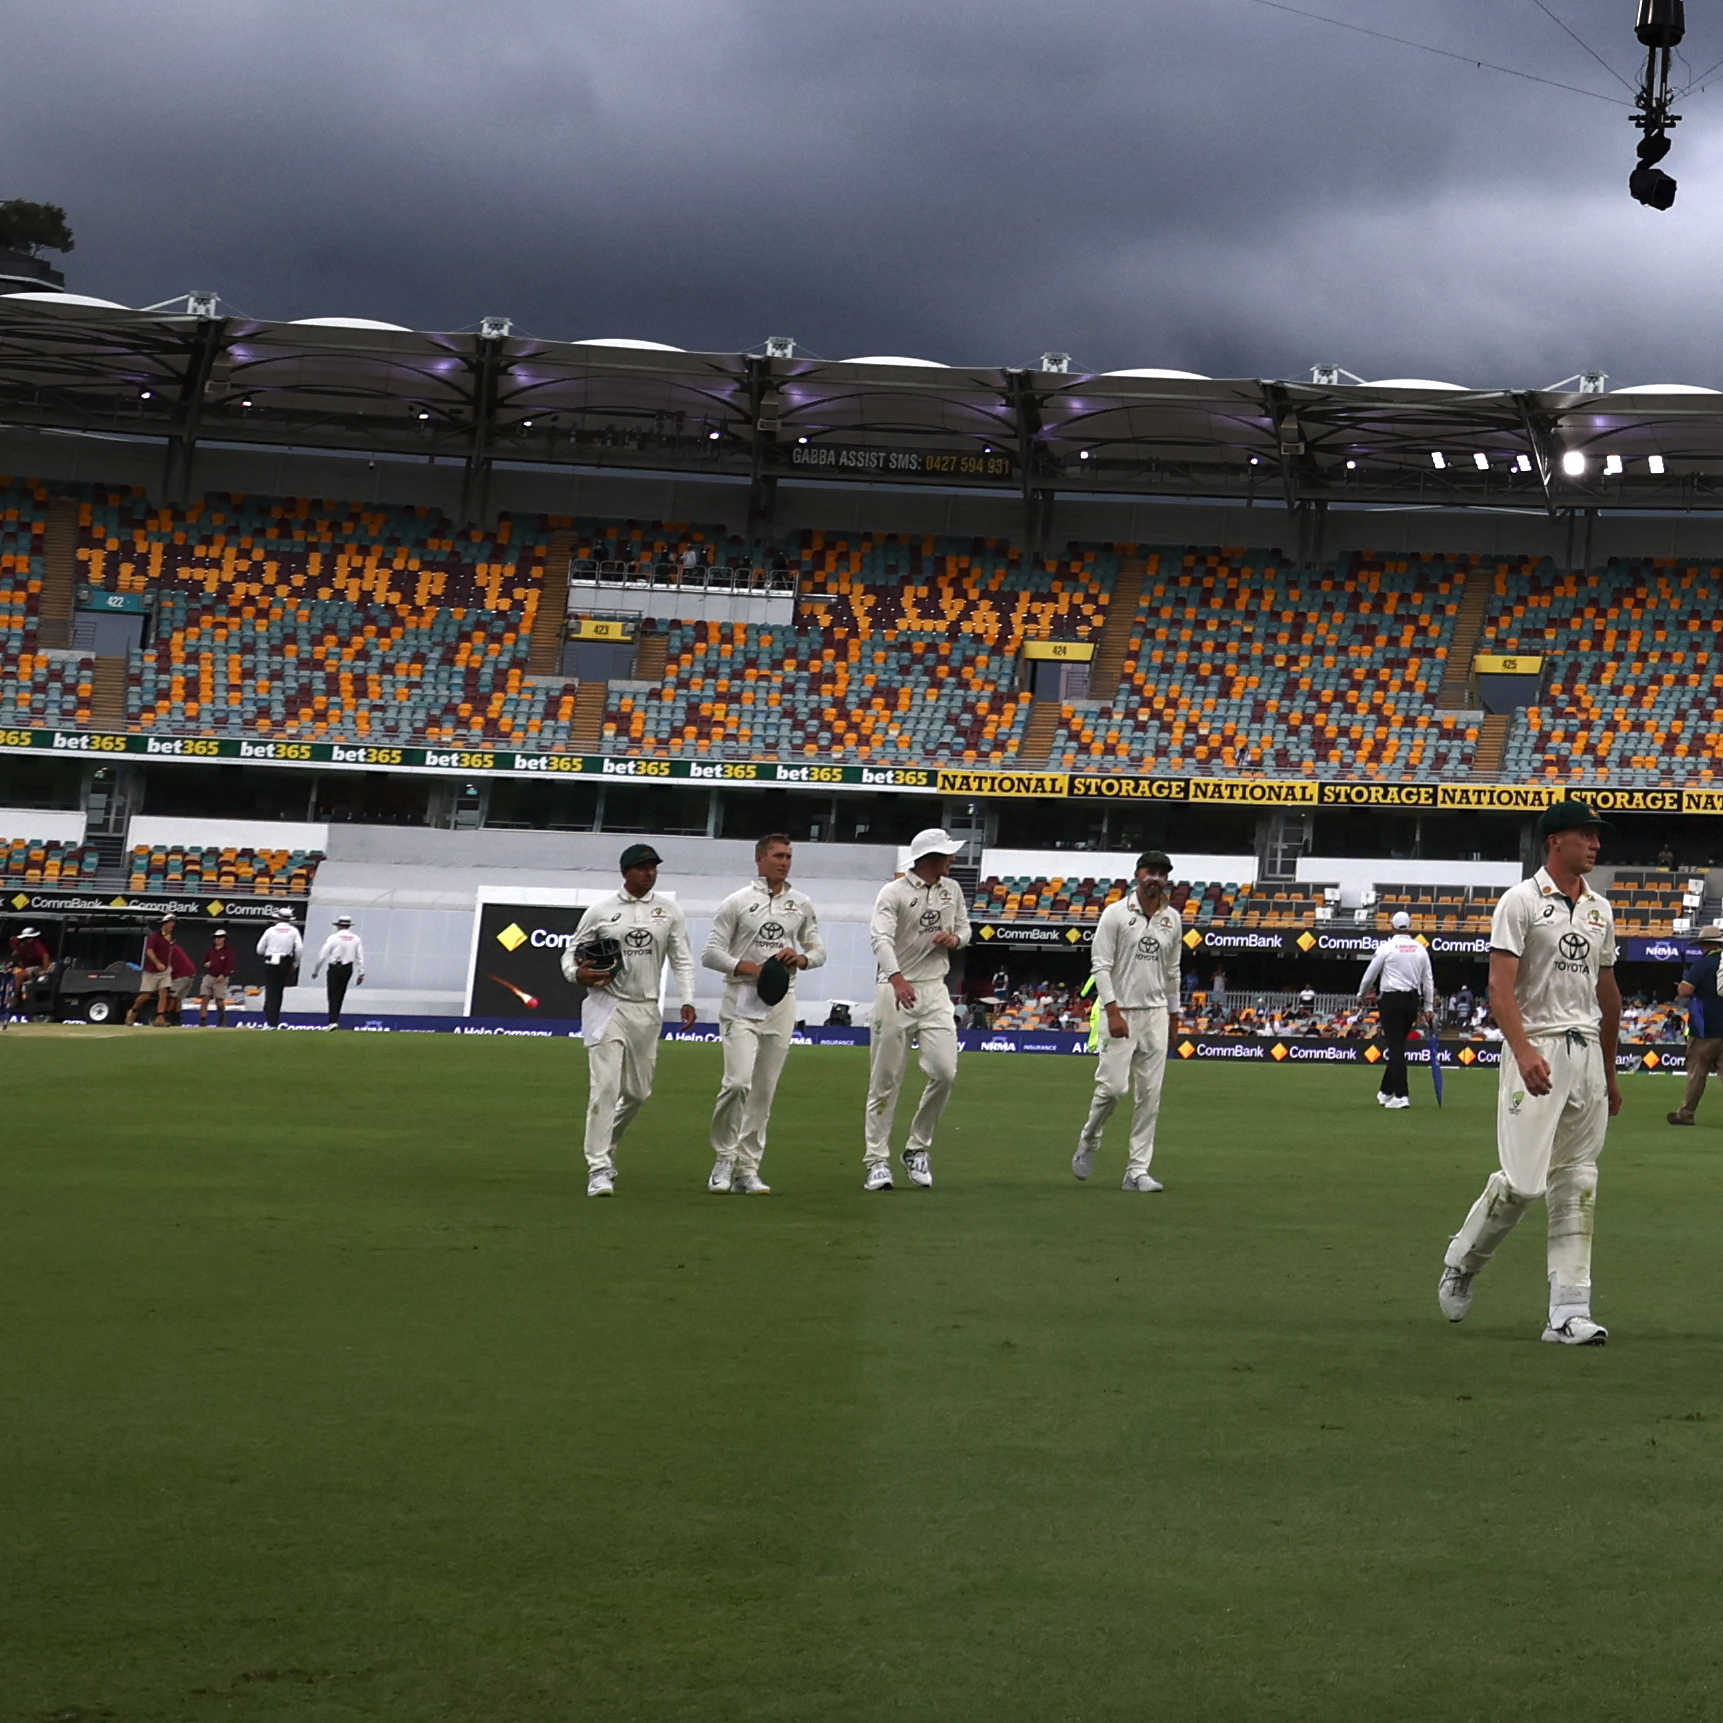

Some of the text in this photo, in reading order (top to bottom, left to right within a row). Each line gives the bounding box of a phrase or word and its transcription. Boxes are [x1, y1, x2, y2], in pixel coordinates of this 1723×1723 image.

[792, 448, 835, 466] GABBA
[839, 450, 885, 468] ASSIST
[889, 453, 922, 470] SMS:
[925, 455, 956, 472] 0427
[960, 457, 983, 474] 594
[53, 733, 127, 751] bet365
[147, 737, 219, 755] bet365
[240, 741, 311, 760] bet365
[331, 746, 402, 764] bet365
[425, 750, 494, 768] bet365
[514, 754, 583, 772] bet365
[602, 757, 670, 776] bet365
[690, 762, 756, 779] bet365
[776, 765, 843, 782] bet365
[861, 768, 928, 785] bet365
[939, 775, 1184, 799] NATIONAL STORAGE
[1191, 781, 1433, 805] NATIONAL STORAGE
[1440, 788, 1560, 809] NATIONAL
[997, 928, 1060, 941] CommBank
[1205, 933, 1282, 948] CommBank
[1553, 961, 1590, 975] TOYOTA
[1197, 1044, 1264, 1058] CommBank
[1290, 1046, 1357, 1060] CommBank
